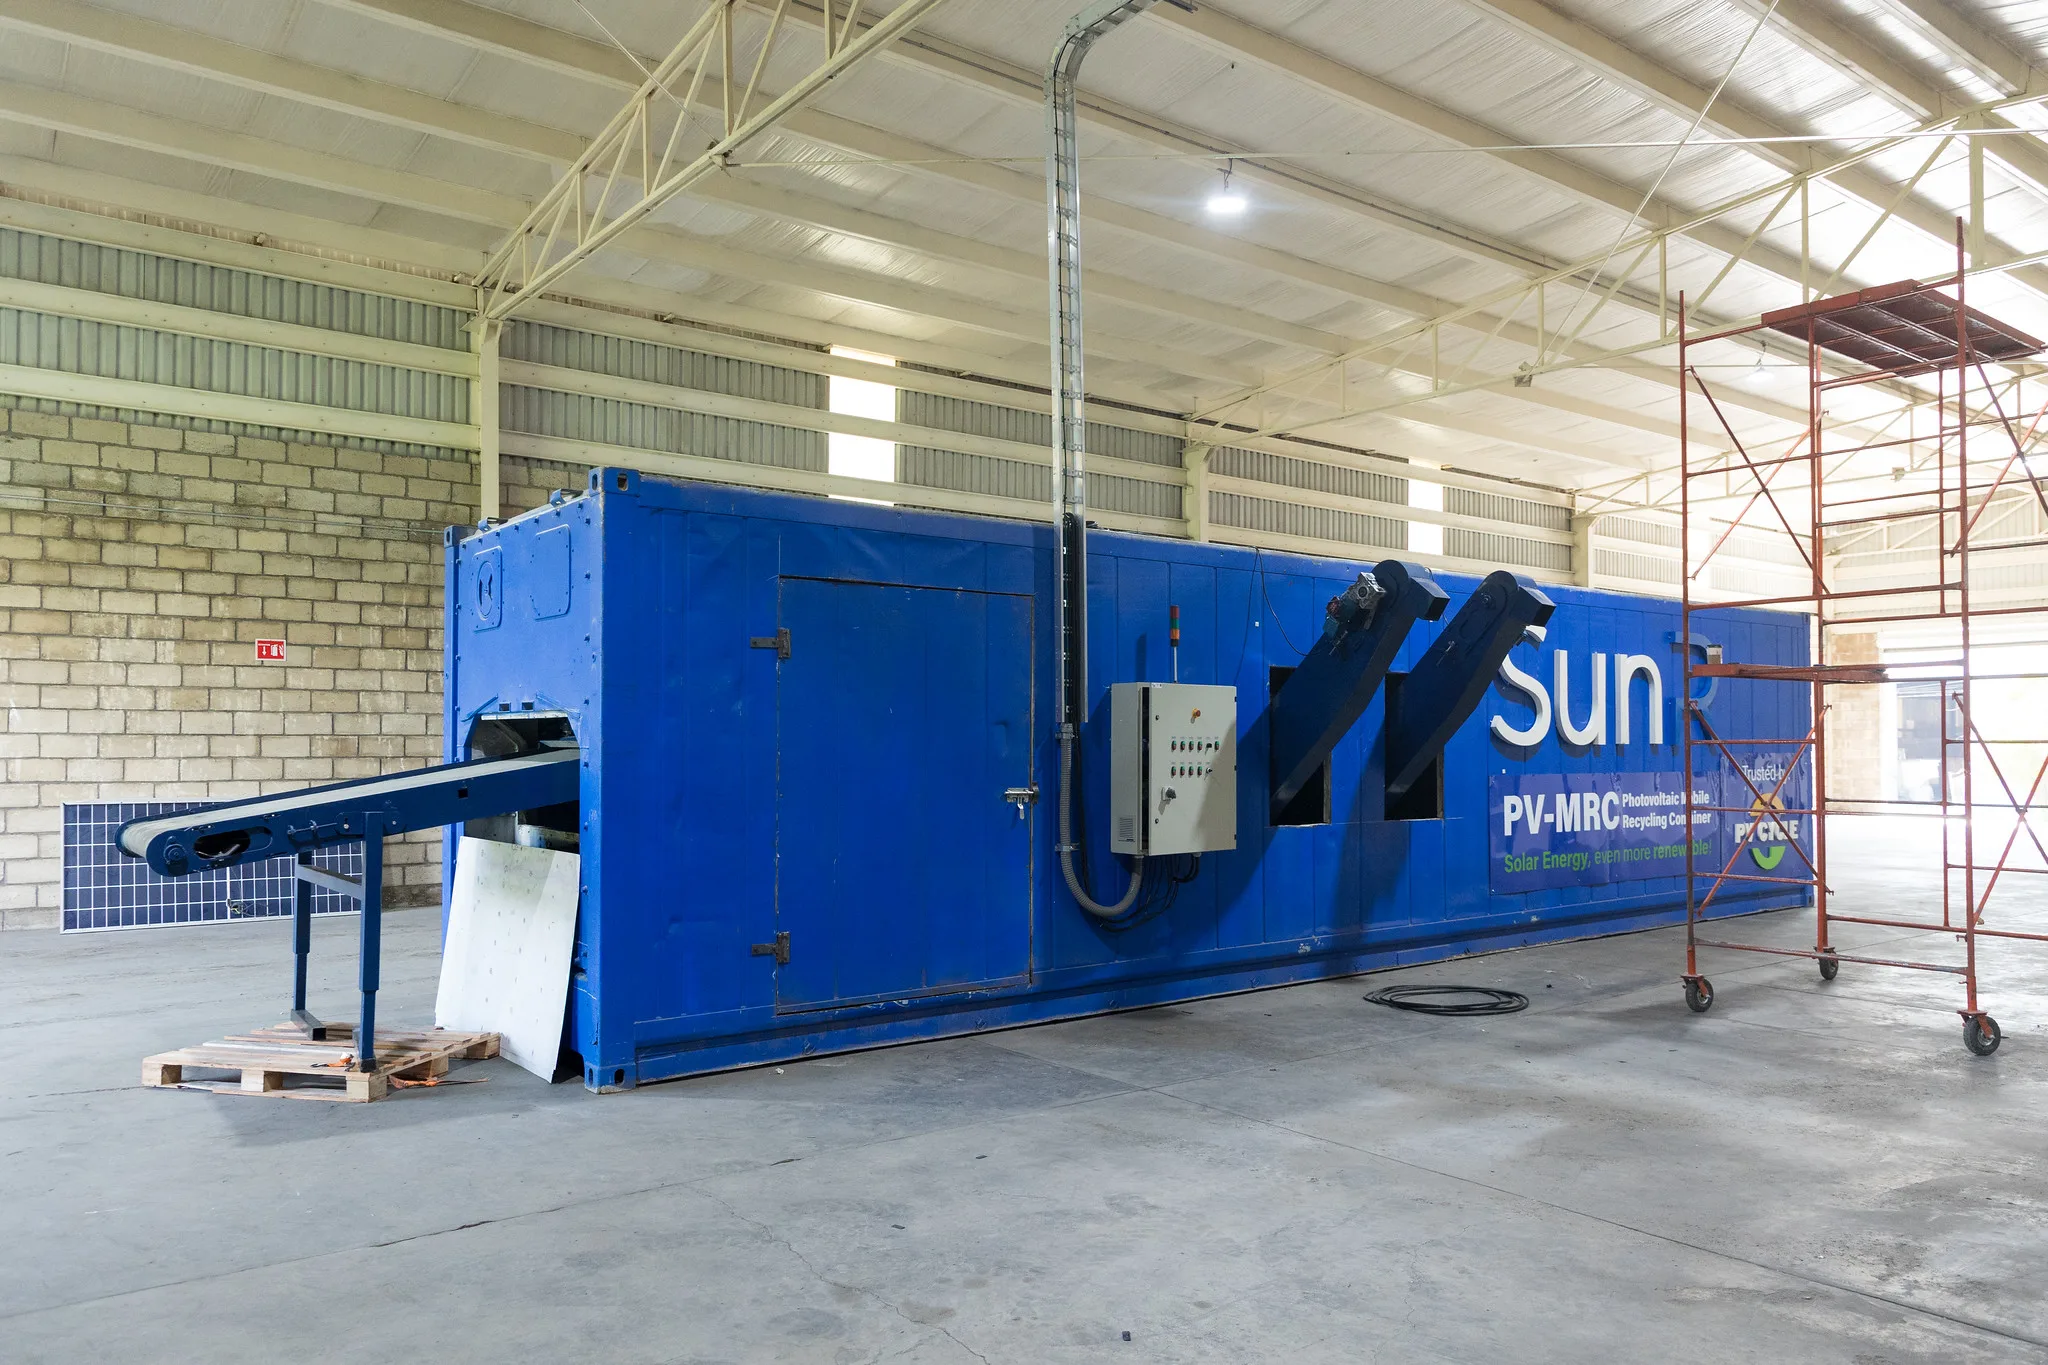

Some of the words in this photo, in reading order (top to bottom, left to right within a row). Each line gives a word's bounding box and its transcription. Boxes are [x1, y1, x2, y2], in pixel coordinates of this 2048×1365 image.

[1742, 763, 1776, 781] Trusted
[1622, 792, 1679, 807] Photovoltaic
[1681, 790, 1710, 805] Mbile
[1503, 791, 1620, 836] PV-MRC
[1622, 812, 1668, 831] Recycling
[1669, 810, 1712, 826] Coniner
[1504, 852, 1539, 873] Solar
[1543, 851, 1591, 871] Energy,
[1594, 849, 1621, 864] even
[1623, 847, 1651, 862] more
[1653, 839, 1712, 860] renewble!
